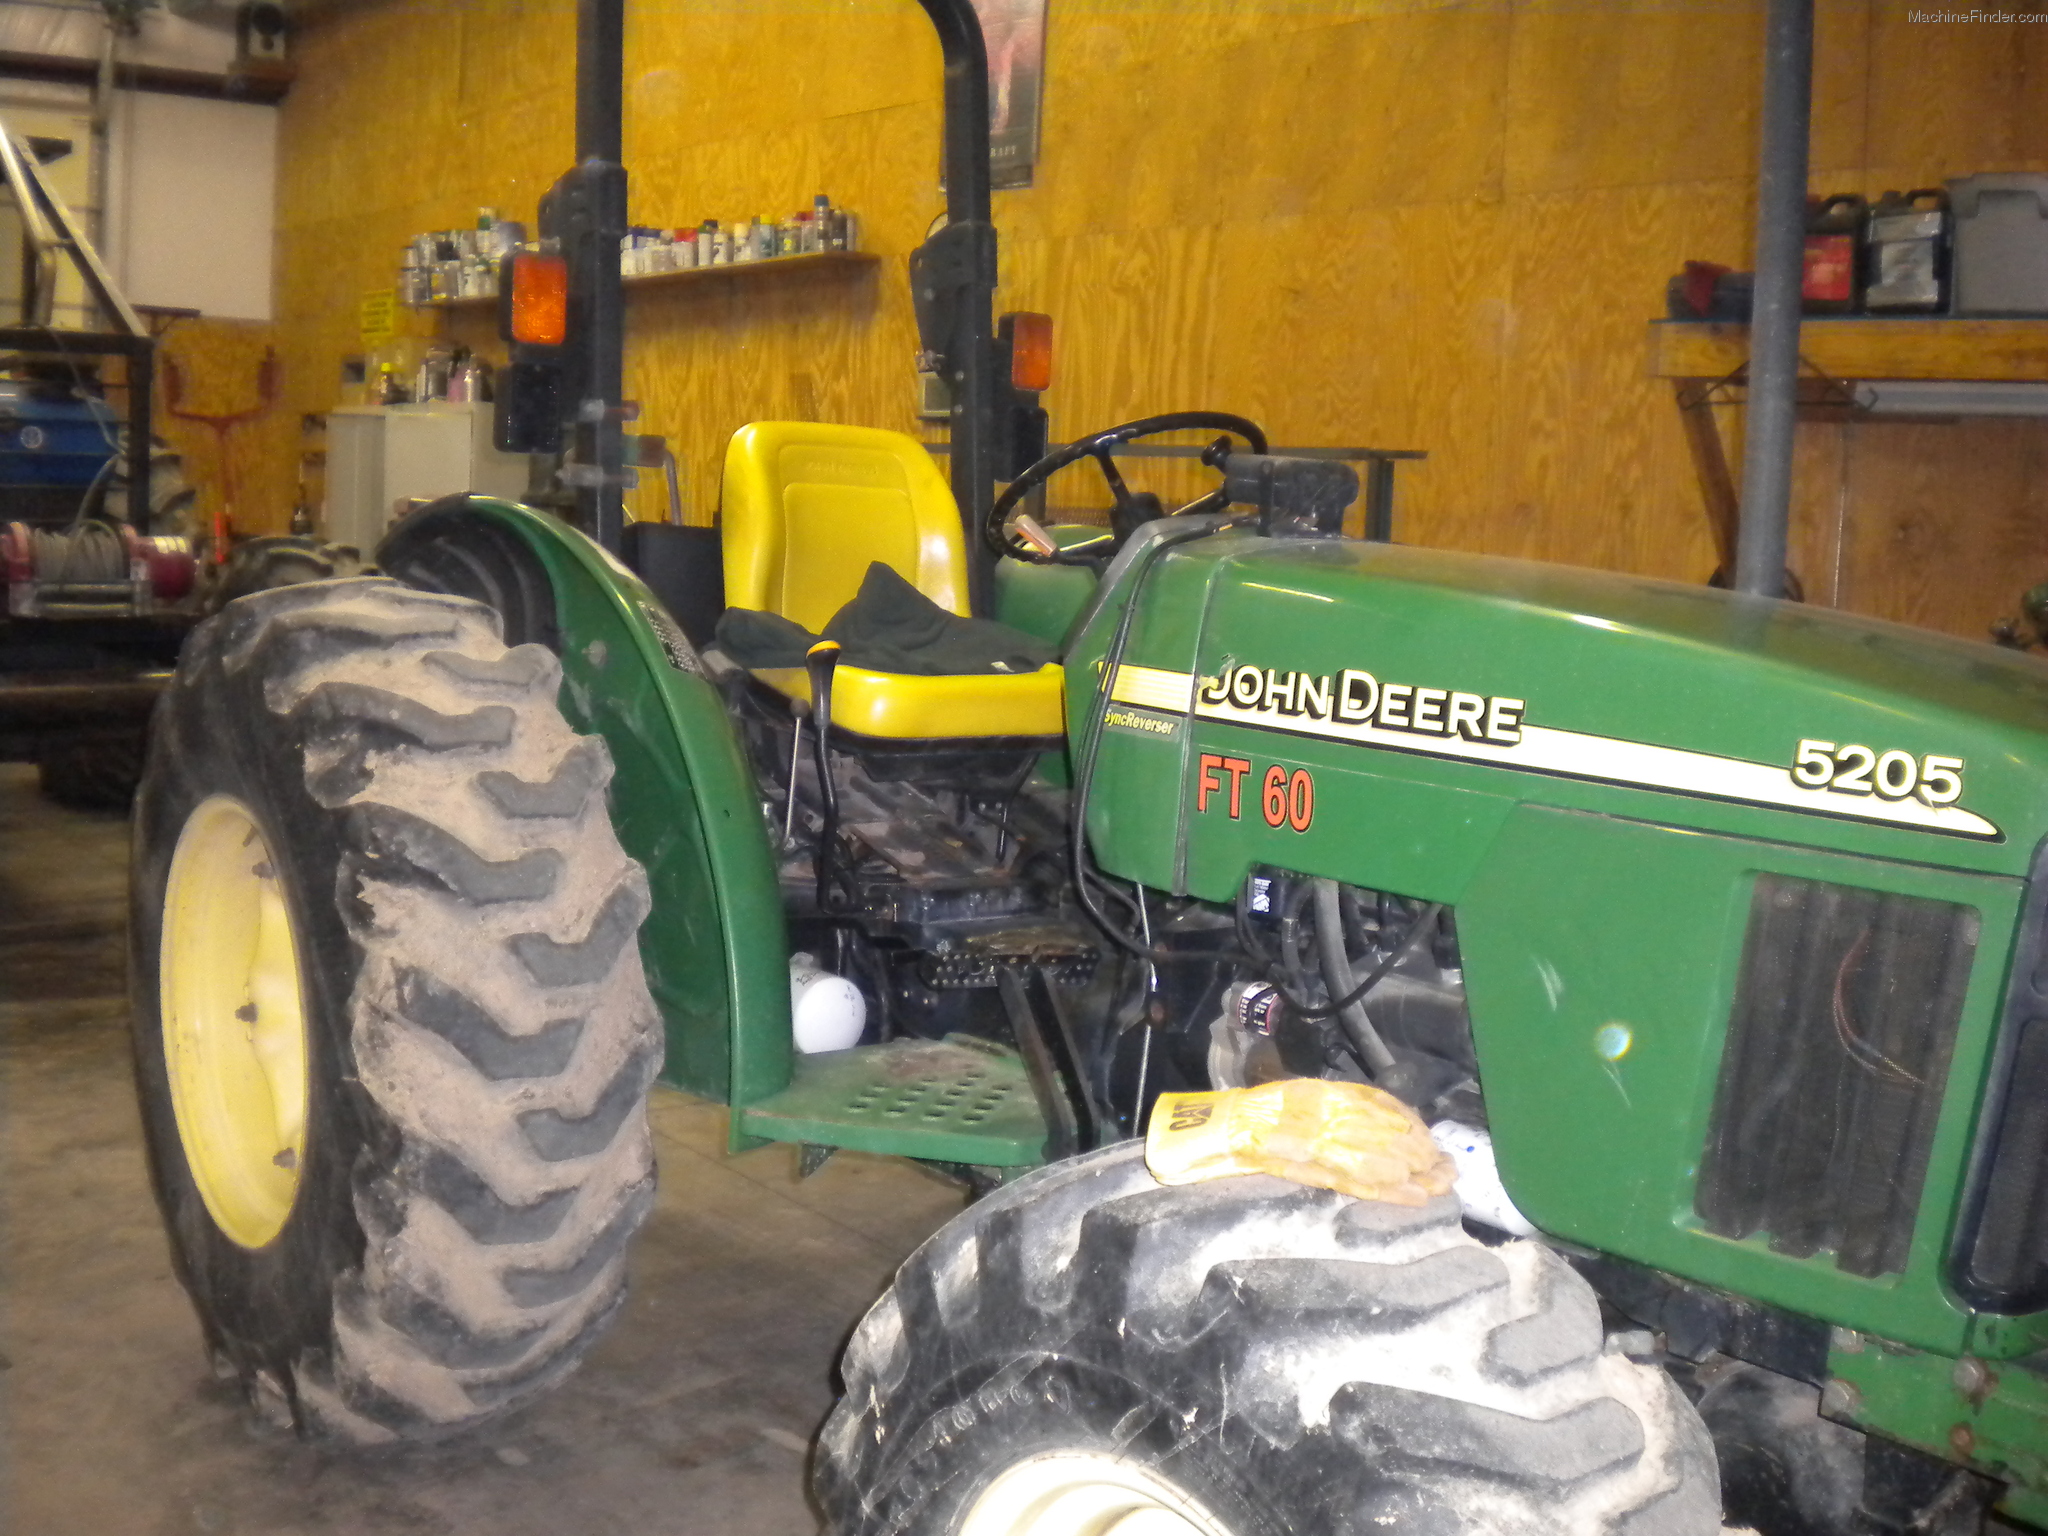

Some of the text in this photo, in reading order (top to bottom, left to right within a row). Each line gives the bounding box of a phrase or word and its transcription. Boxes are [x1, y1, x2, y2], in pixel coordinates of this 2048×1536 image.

[1104, 708, 1175, 735] SyncReverser
[1202, 664, 1527, 746] JOHN DEERE
[1197, 753, 1314, 834] FT 60
[1790, 738, 1965, 808] 5205
[1169, 1102, 1215, 1132] CAT
